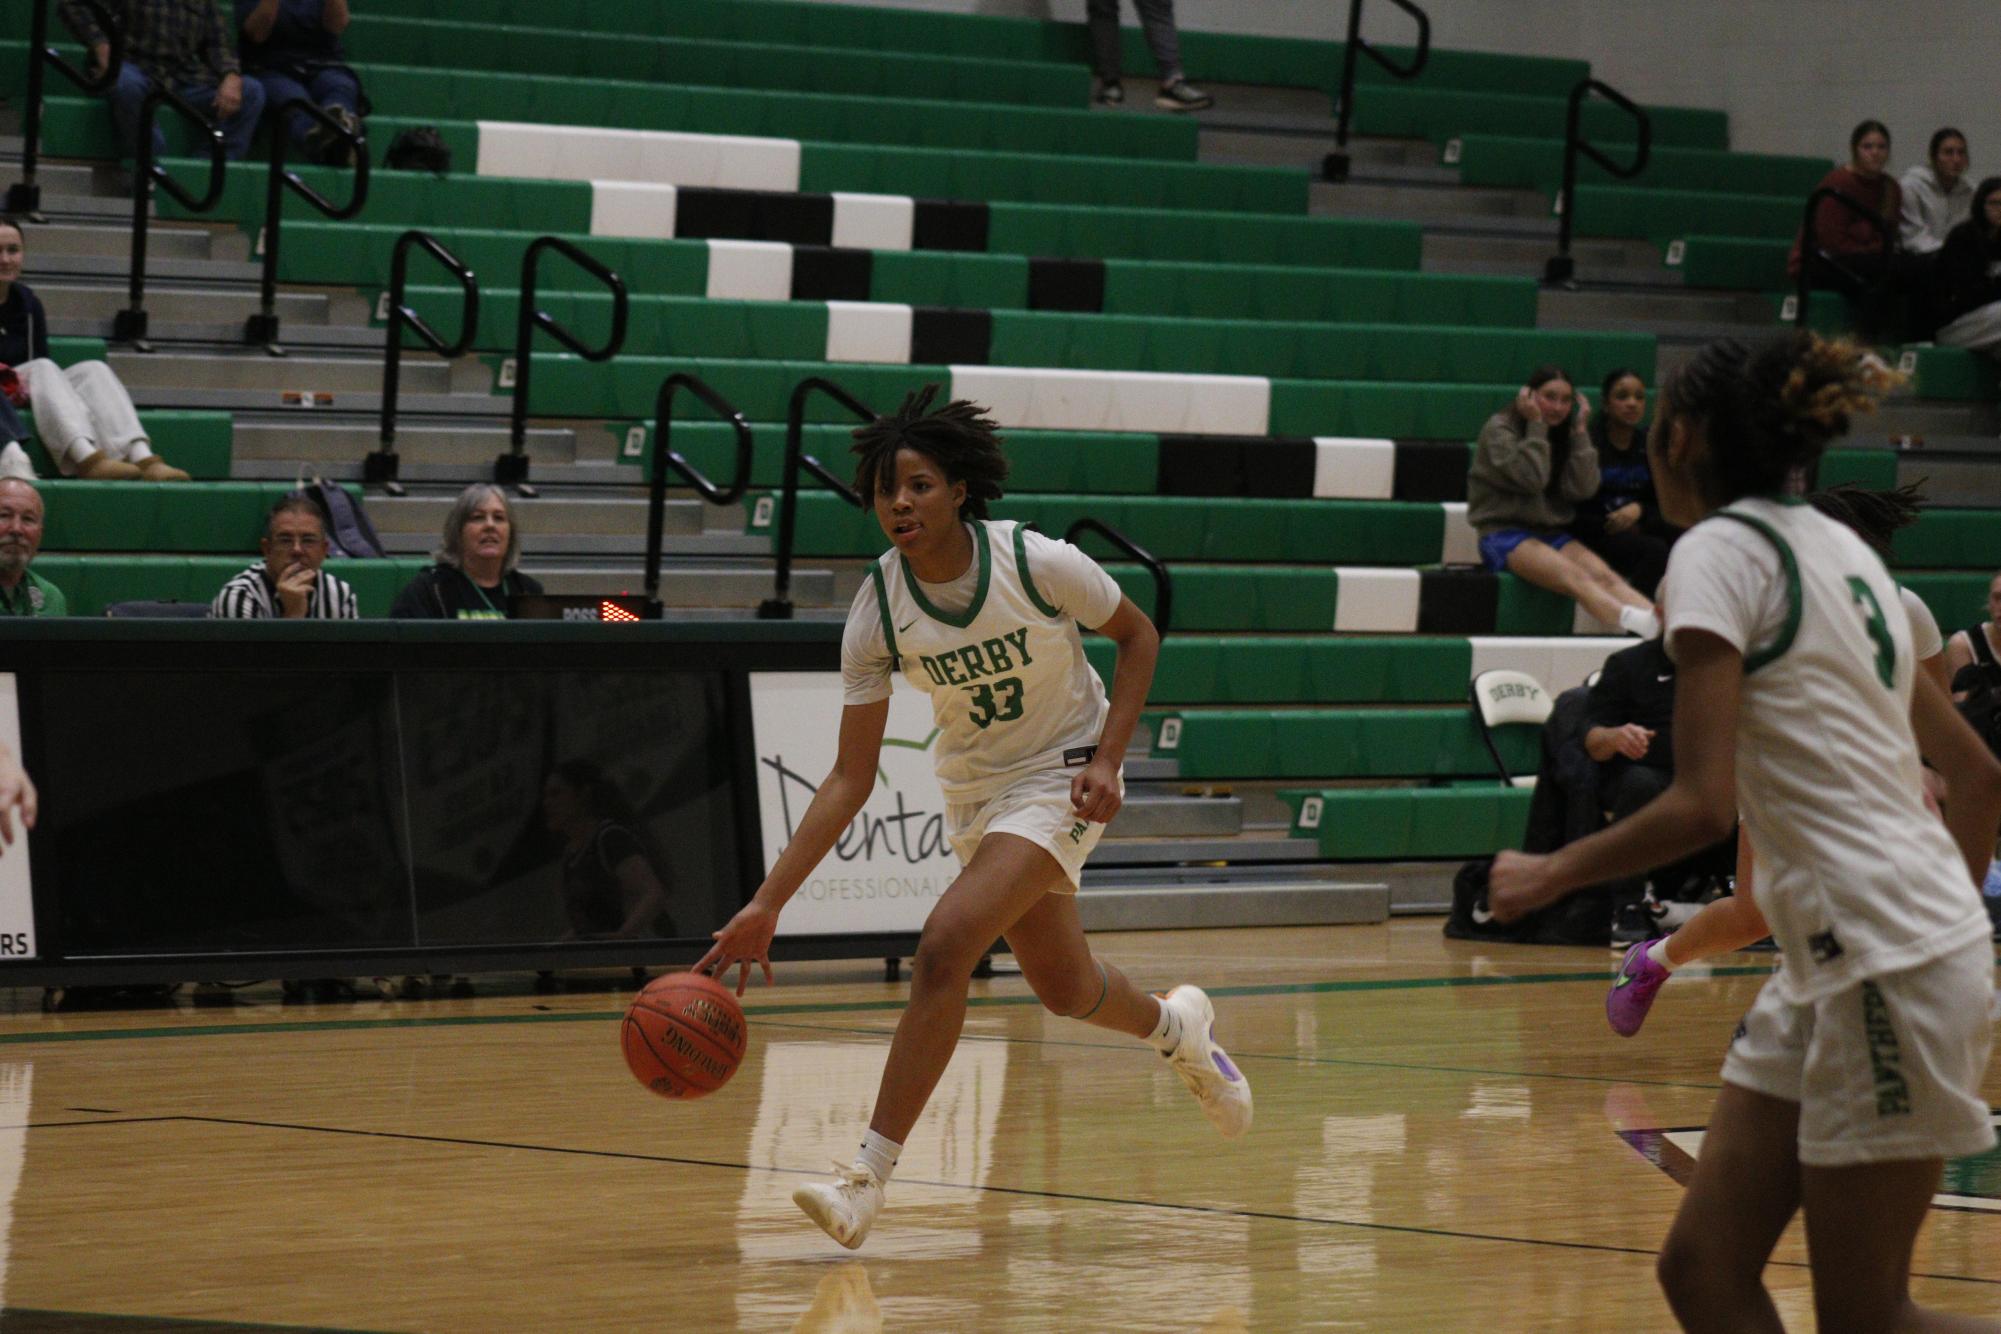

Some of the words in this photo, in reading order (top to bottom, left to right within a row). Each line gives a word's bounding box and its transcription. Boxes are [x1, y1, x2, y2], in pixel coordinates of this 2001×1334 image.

[919, 627, 1032, 686] DERBY
[960, 676, 1024, 729] 33
[1489, 683, 1539, 702] DERBY
